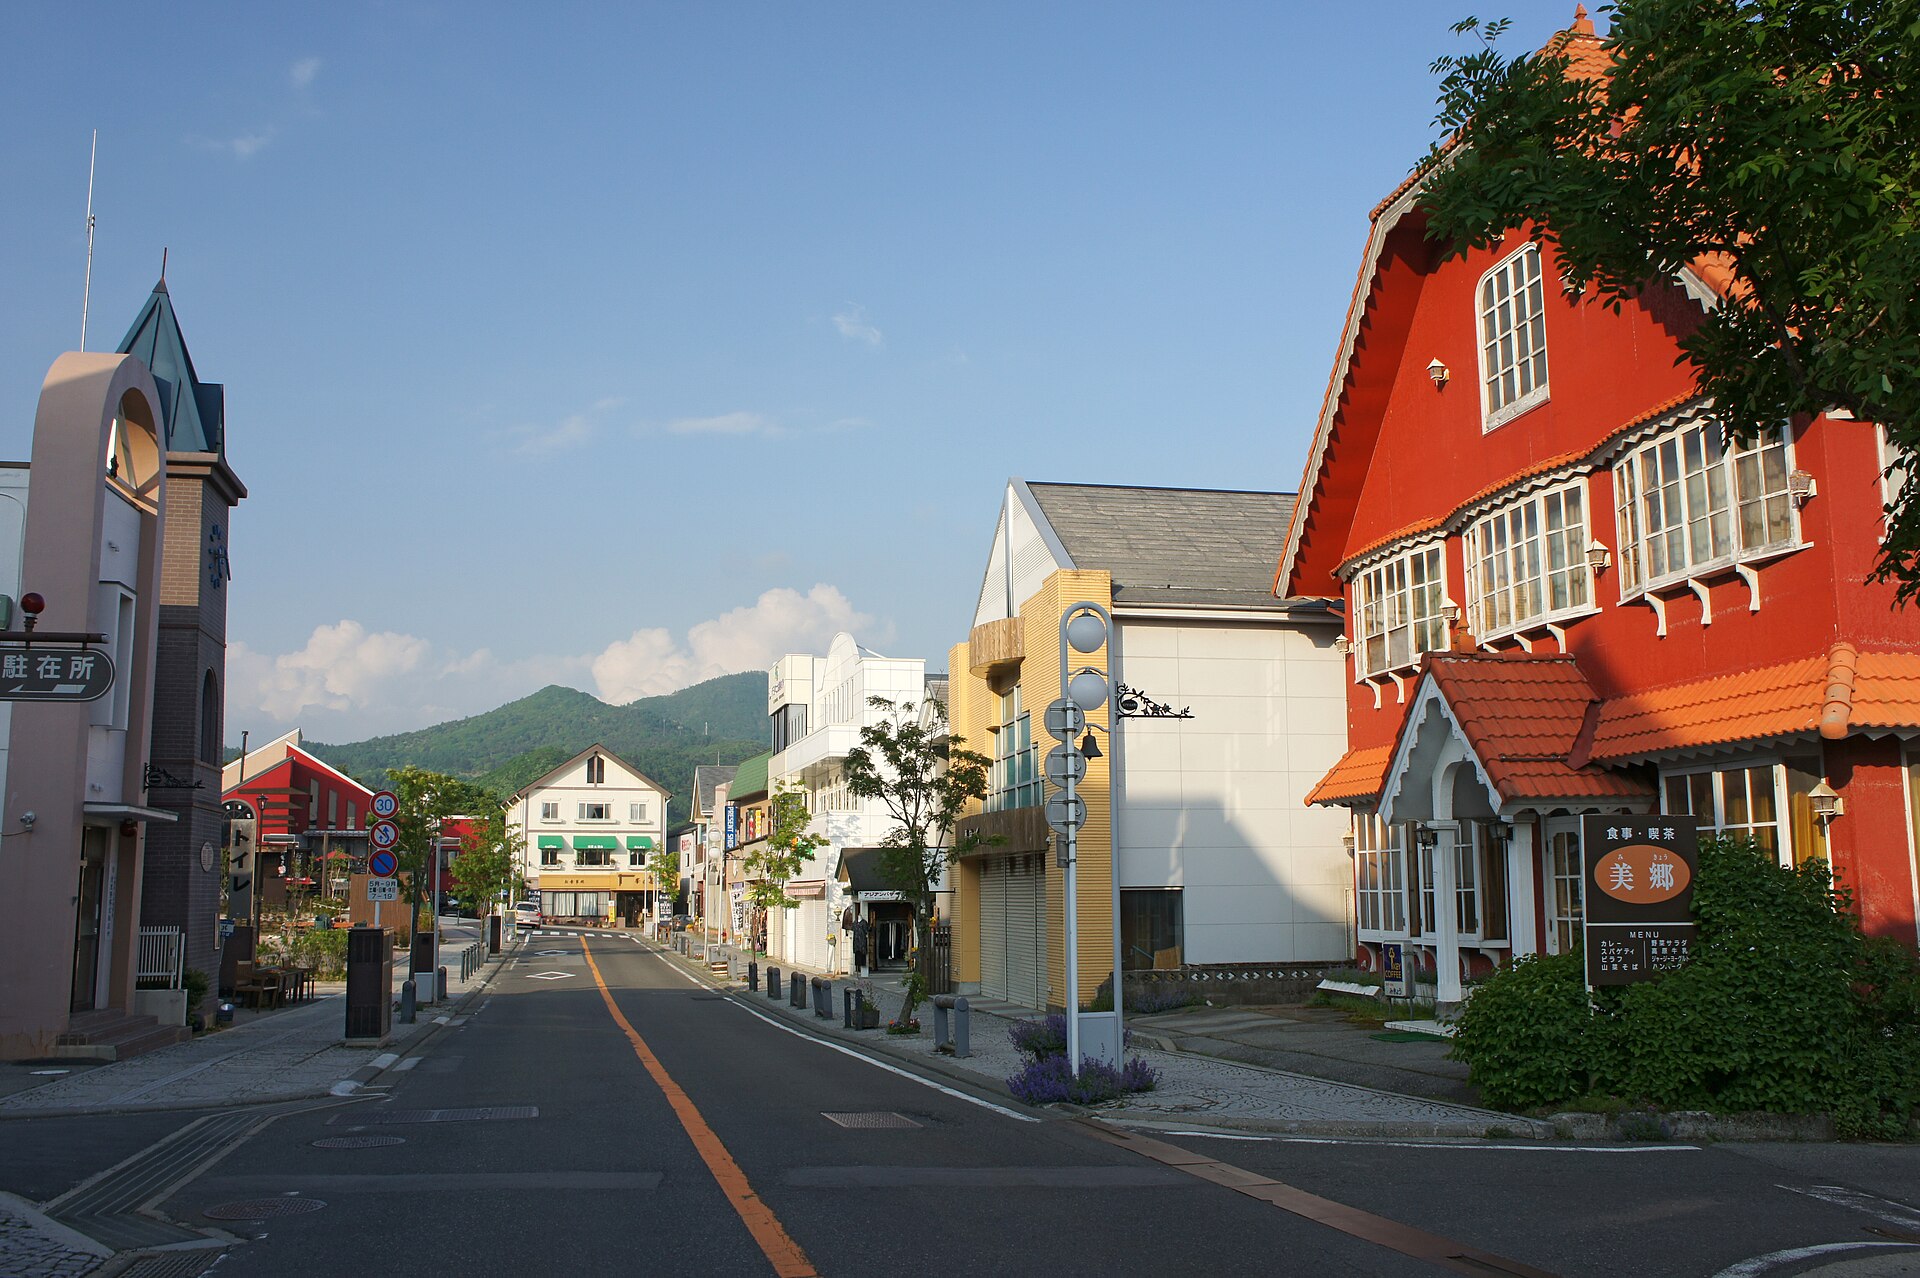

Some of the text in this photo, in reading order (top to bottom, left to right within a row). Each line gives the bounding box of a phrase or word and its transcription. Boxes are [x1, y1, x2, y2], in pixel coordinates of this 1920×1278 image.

[2, 654, 95, 680] 駐在所
[376, 798, 393, 812] 30
[1606, 826, 1675, 840] 食事・喫茶
[231, 829, 250, 892] トイレ
[1609, 862, 1675, 891] 美郷
[1629, 931, 1659, 939] MENU
[1650, 939, 1688, 947] 野菜サラダ
[1650, 947, 1689, 955] 高原牛乳
[1601, 963, 1639, 971] 山菜そば
[1385, 970, 1401, 978] COFFEE
